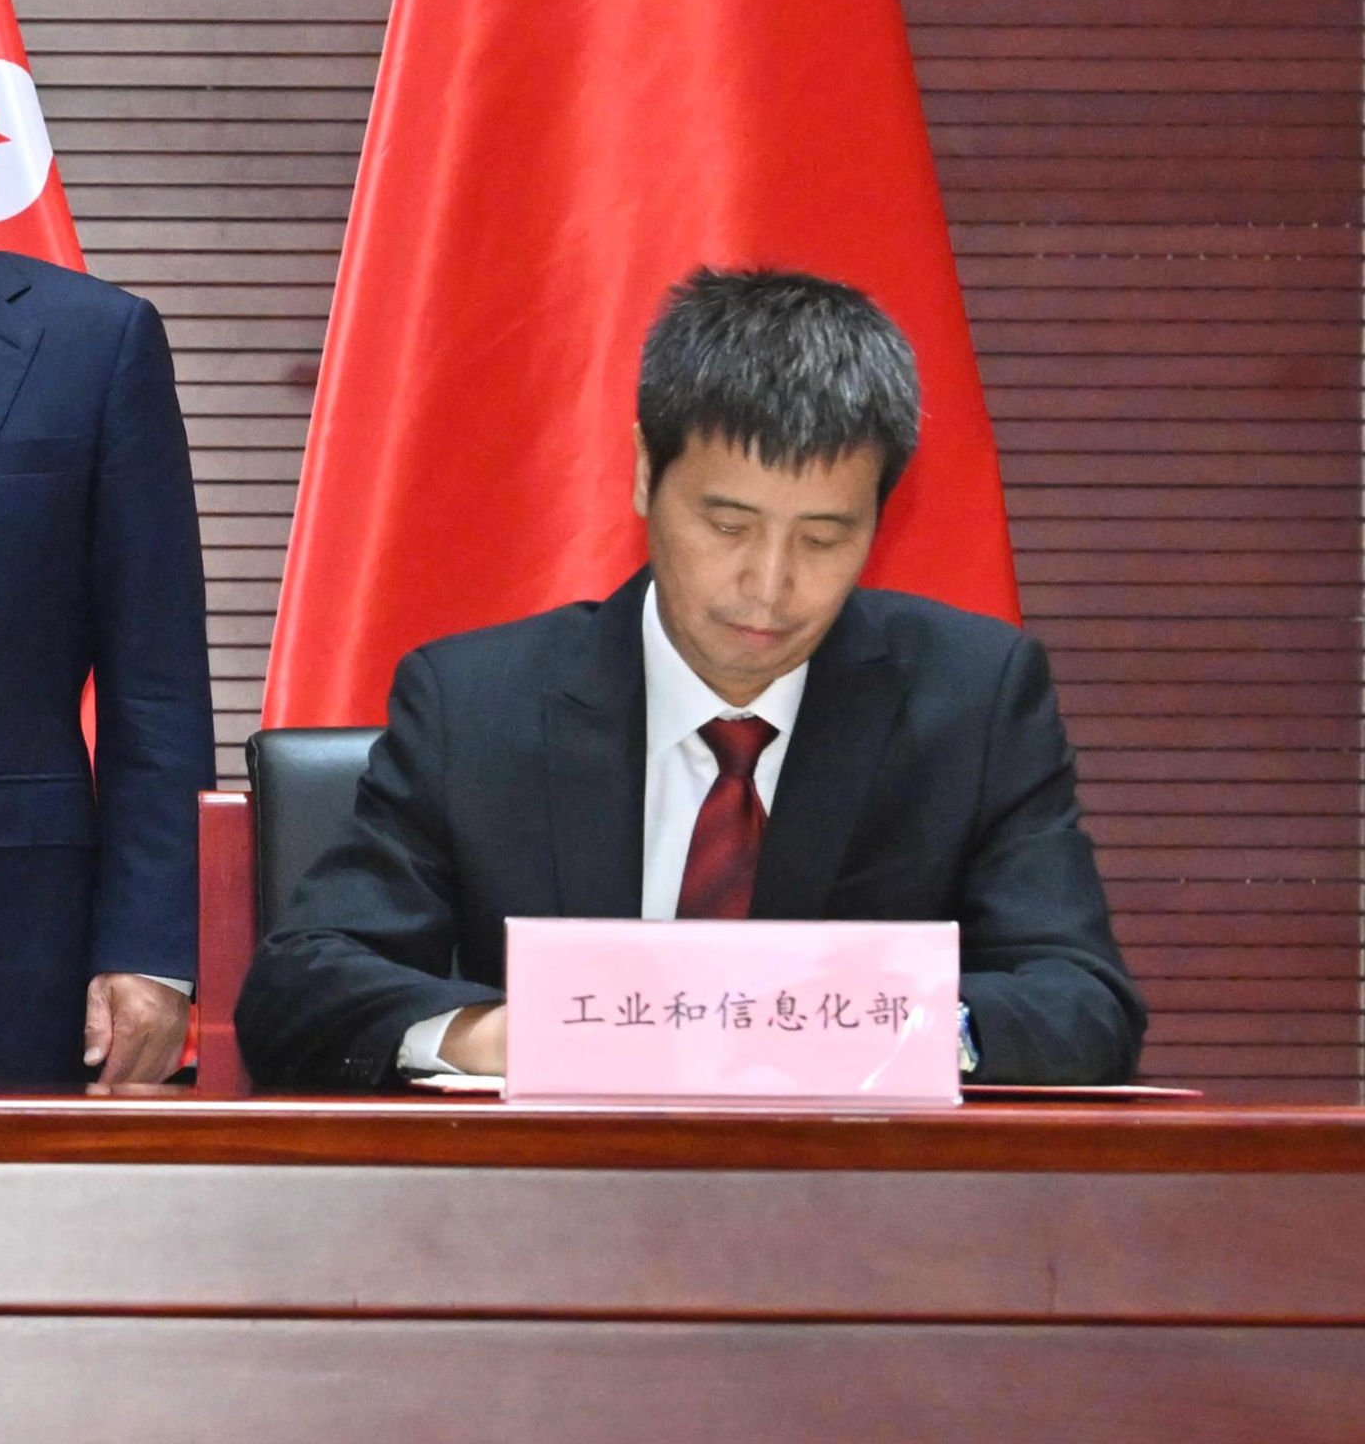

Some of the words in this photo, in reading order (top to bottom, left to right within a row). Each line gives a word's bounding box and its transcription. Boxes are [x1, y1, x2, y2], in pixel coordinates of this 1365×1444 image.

[562, 990, 910, 1034] 工业和信息化部
